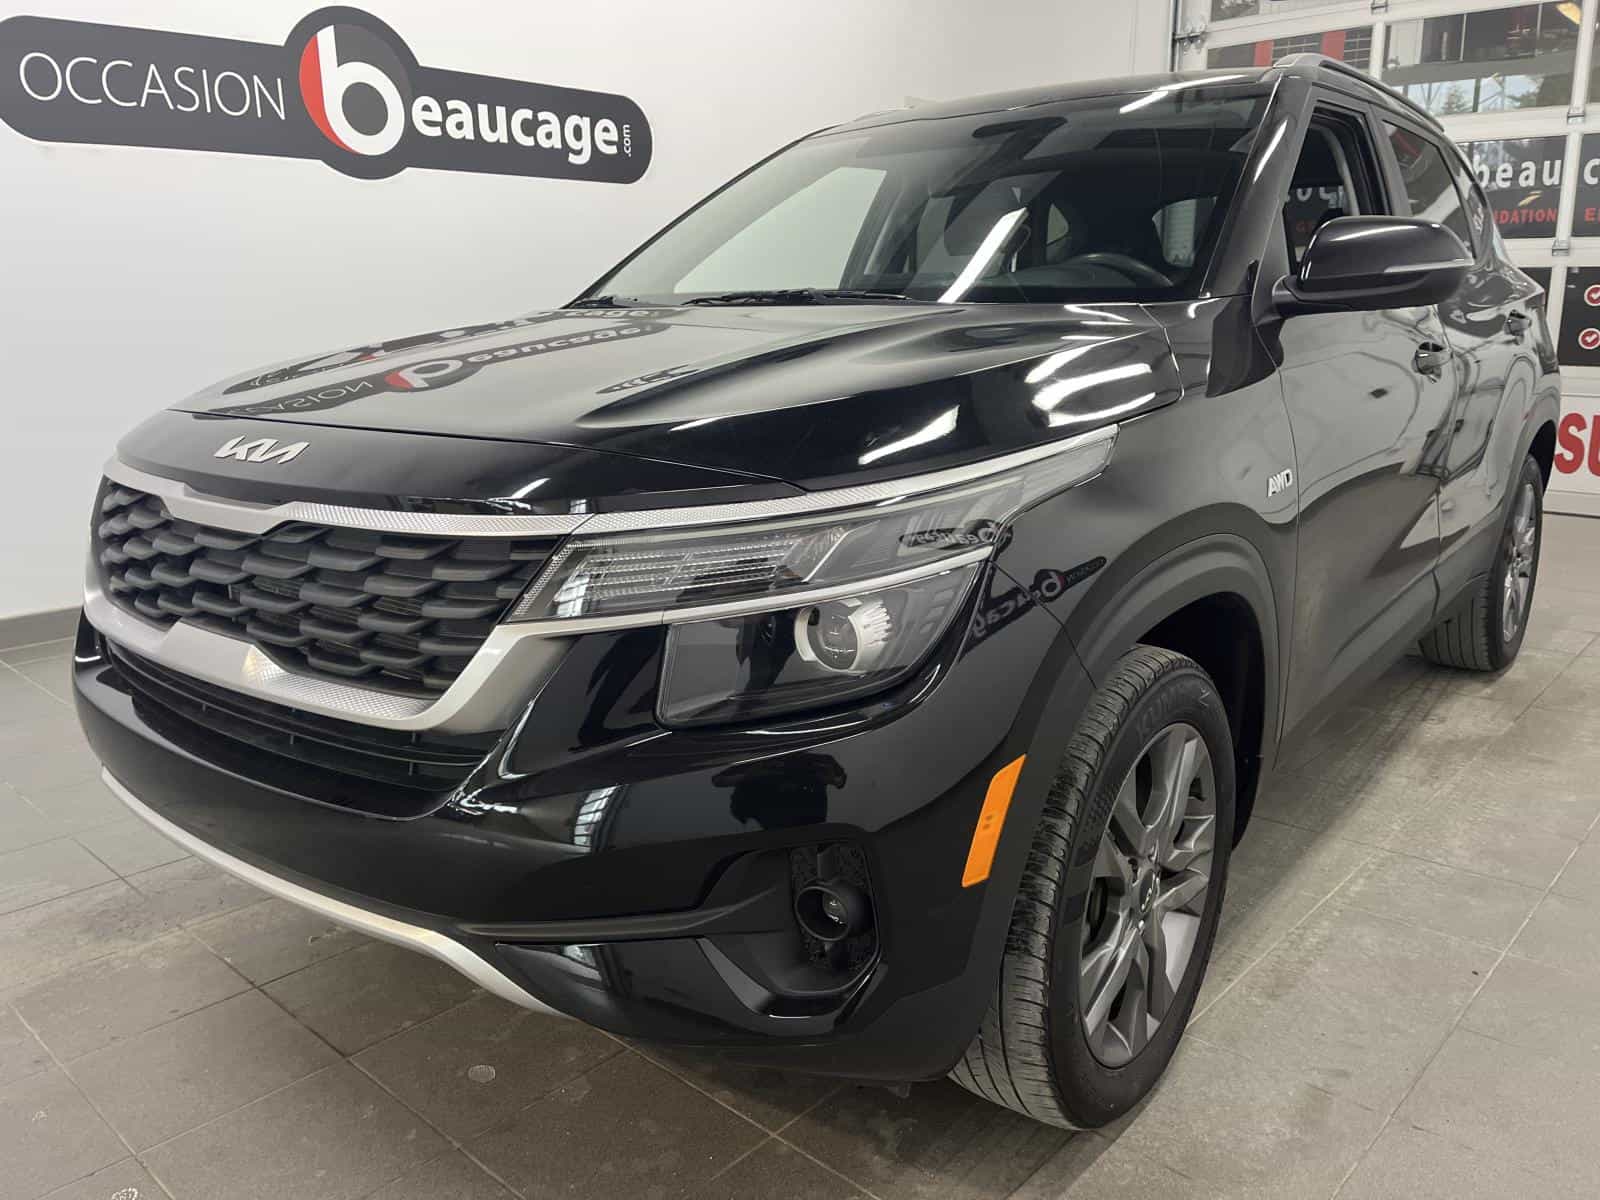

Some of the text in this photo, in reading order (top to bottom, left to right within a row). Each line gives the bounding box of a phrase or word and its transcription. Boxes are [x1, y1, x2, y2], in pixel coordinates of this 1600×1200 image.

[19, 24, 633, 165] OCCASION beaucage .com
[1584, 207, 1600, 222] E
[213, 435, 310, 464] KIA
[1267, 468, 1294, 497] AWD
